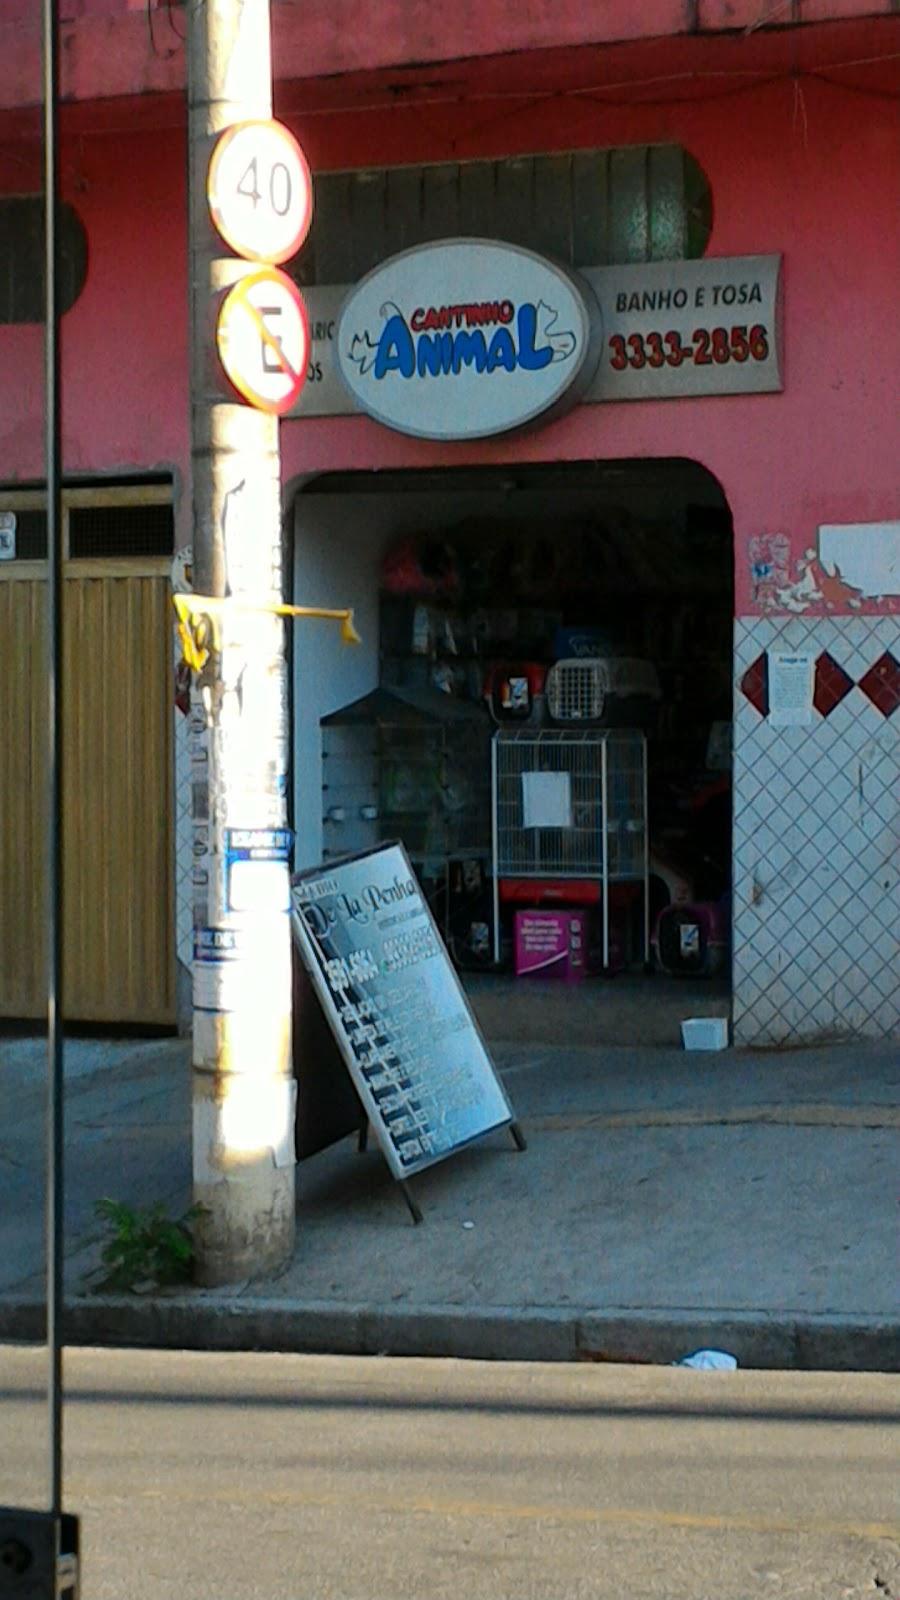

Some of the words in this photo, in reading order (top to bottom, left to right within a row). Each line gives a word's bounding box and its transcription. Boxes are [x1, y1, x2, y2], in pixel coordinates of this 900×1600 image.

[236, 156, 292, 217] 40
[410, 299, 515, 332] CANTINHO
[615, 288, 688, 313] BANHO
[694, 285, 706, 308] E
[712, 282, 763, 306] TOSA
[373, 303, 554, 380] ANIMAL
[608, 323, 769, 371] 3333-2856
